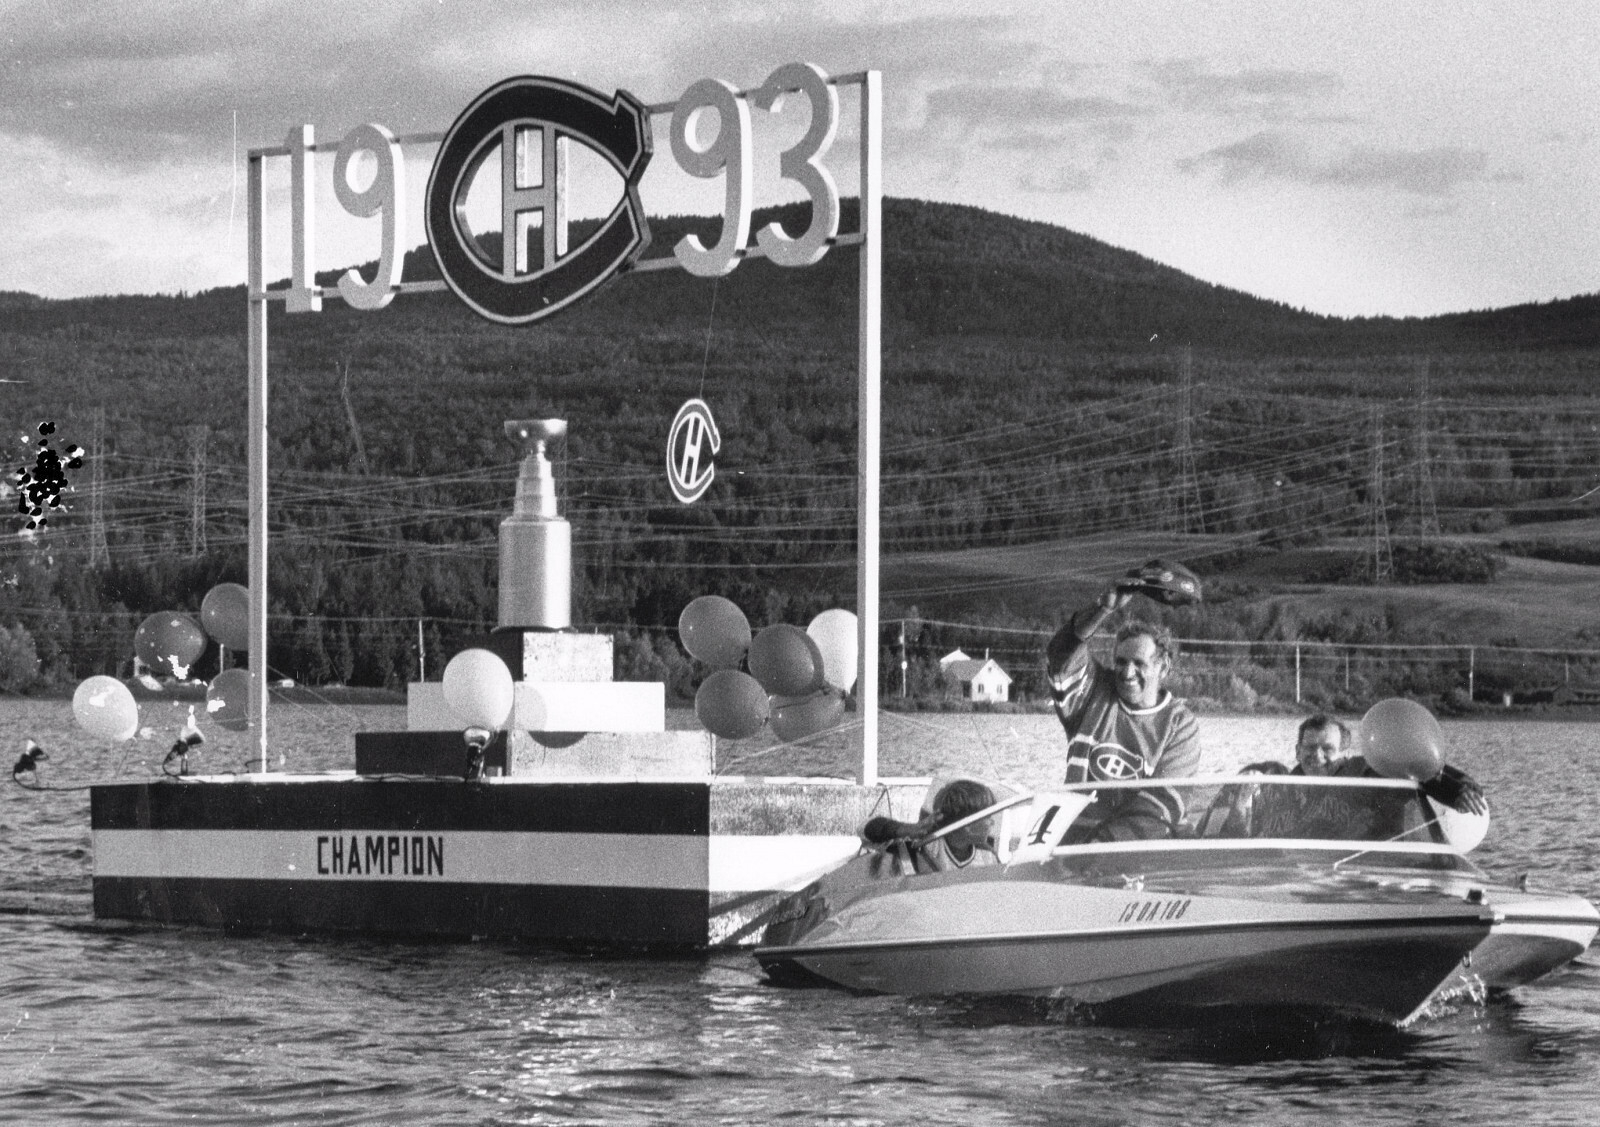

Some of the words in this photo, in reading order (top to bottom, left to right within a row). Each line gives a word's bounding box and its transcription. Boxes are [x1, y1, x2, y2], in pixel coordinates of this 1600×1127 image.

[285, 122, 405, 313] 19
[669, 61, 841, 277] 93
[1027, 804, 1062, 846] 4
[316, 835, 444, 876] CHAMPION
